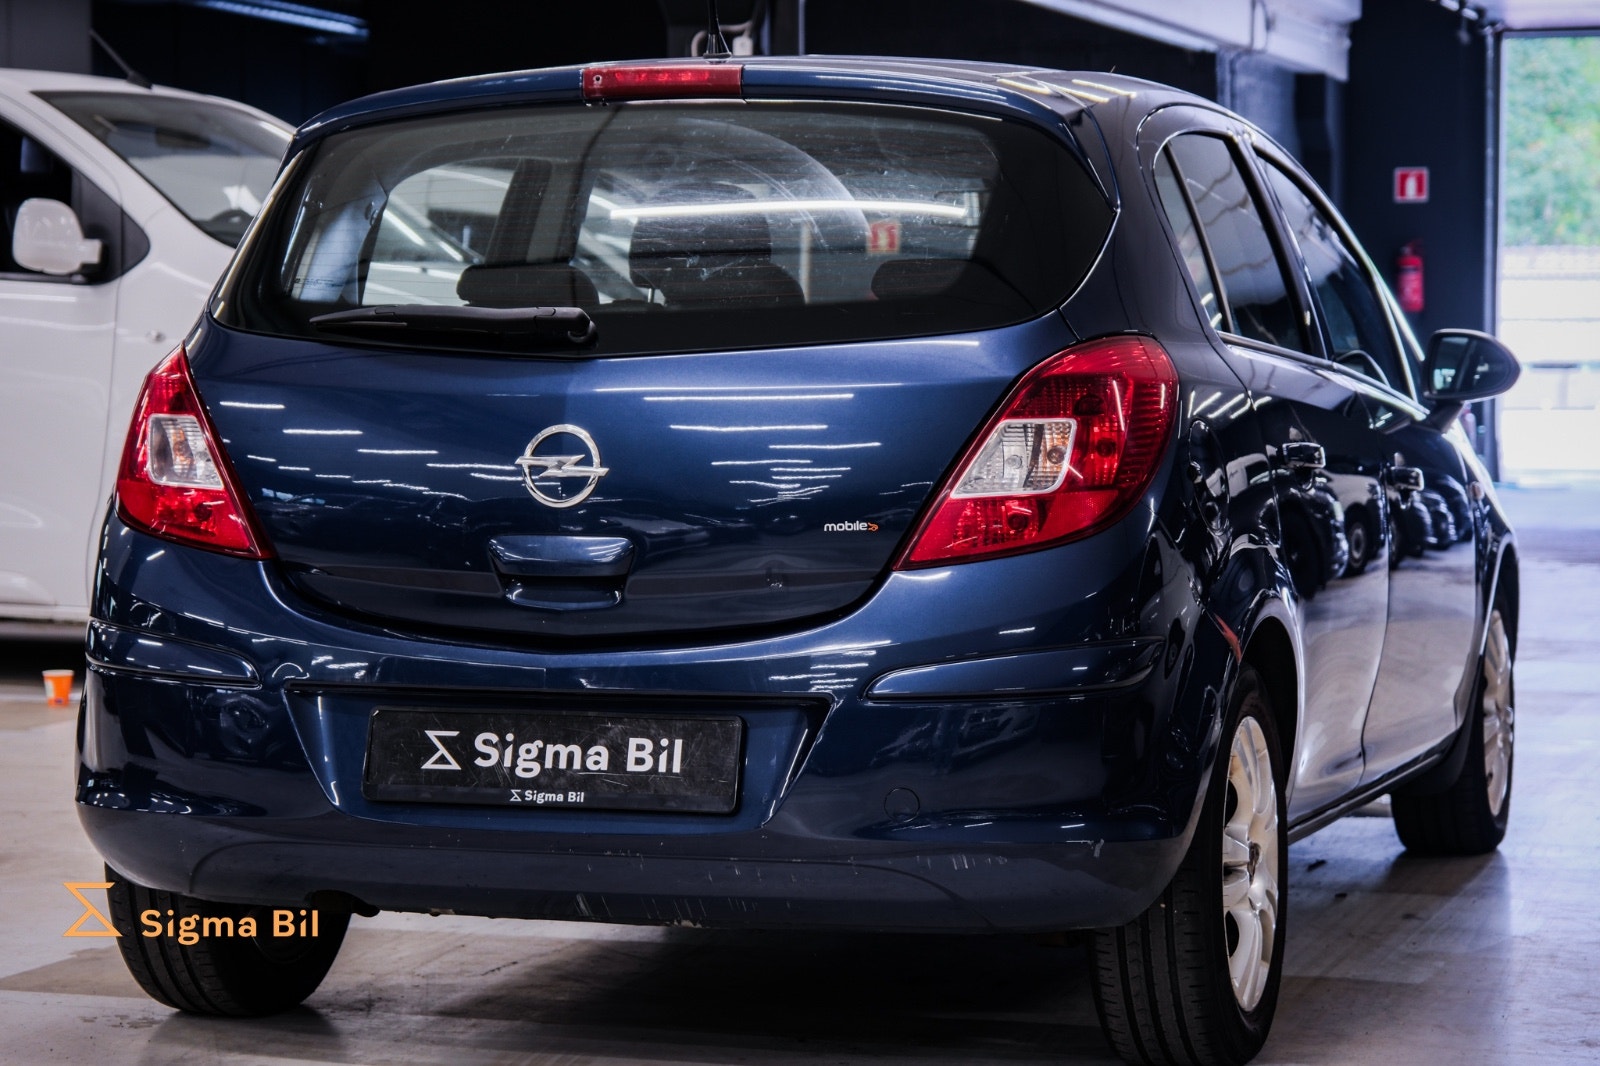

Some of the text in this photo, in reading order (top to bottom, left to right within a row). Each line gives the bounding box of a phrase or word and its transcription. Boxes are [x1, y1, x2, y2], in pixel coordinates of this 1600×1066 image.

[474, 731, 683, 779] Sigma Bil
[524, 789, 585, 804] Sigma Bil
